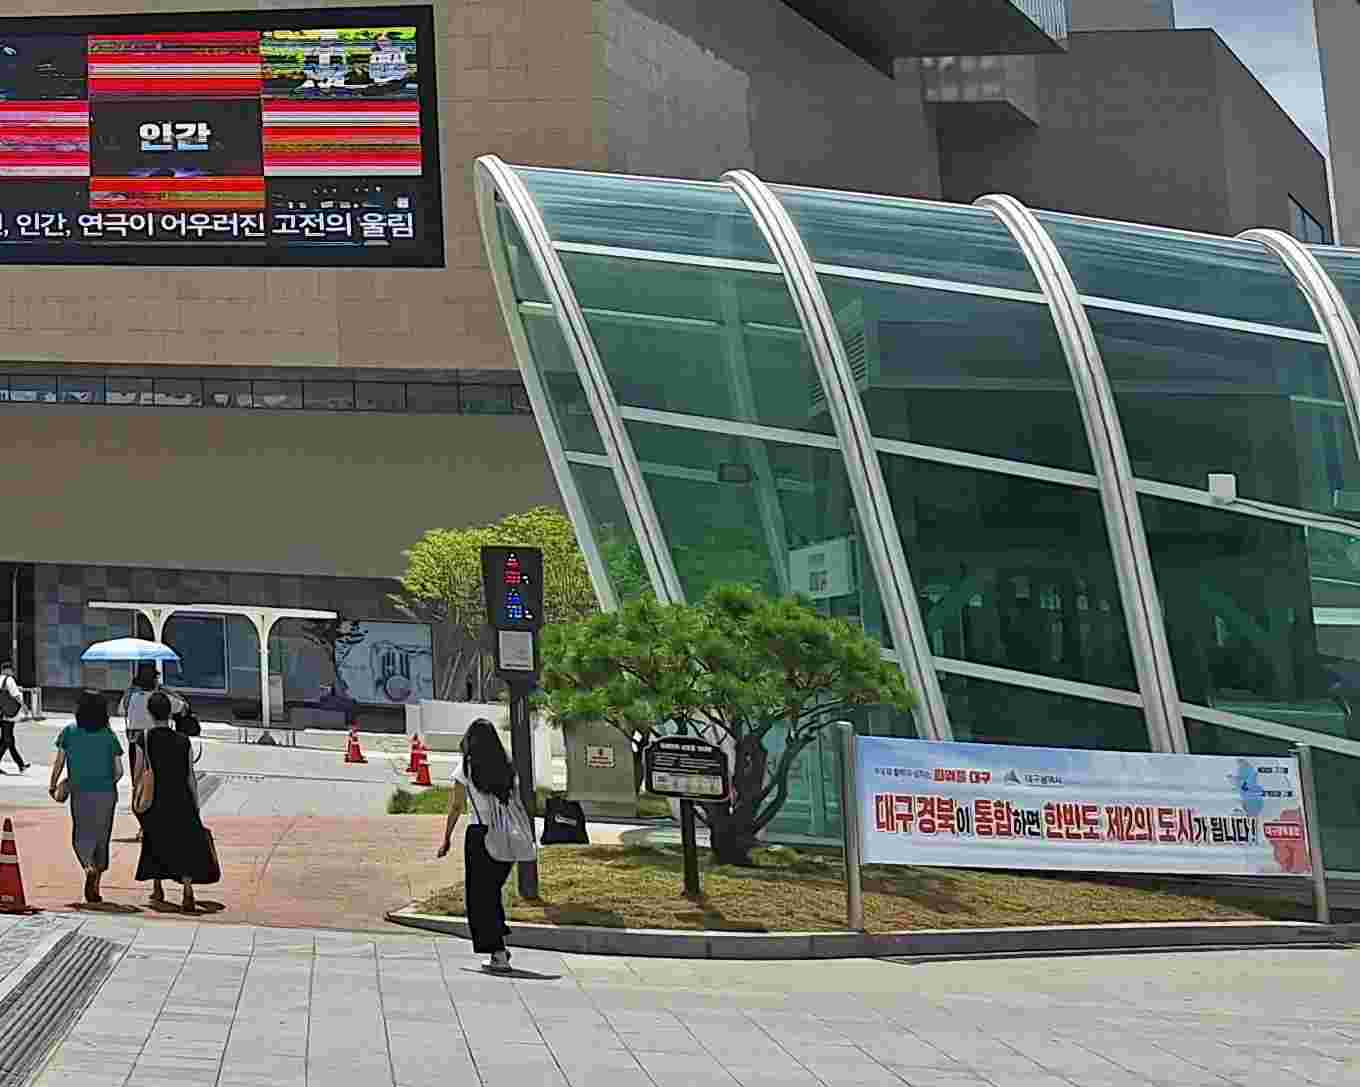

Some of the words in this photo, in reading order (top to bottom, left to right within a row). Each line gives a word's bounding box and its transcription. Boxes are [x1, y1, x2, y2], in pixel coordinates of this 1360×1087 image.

[139, 122, 211, 151] 인간
[16, 213, 71, 238] 인간,
[161, 212, 266, 237] 어우러진
[272, 212, 352, 237] 고전의
[360, 212, 415, 238] 울림
[975, 799, 1041, 837] 통합하면
[1043, 801, 1101, 840] 한반도
[1104, 805, 1153, 842] 제2의
[1157, 807, 1208, 843] 도시가
[1210, 815, 1257, 843] 됩니다!
